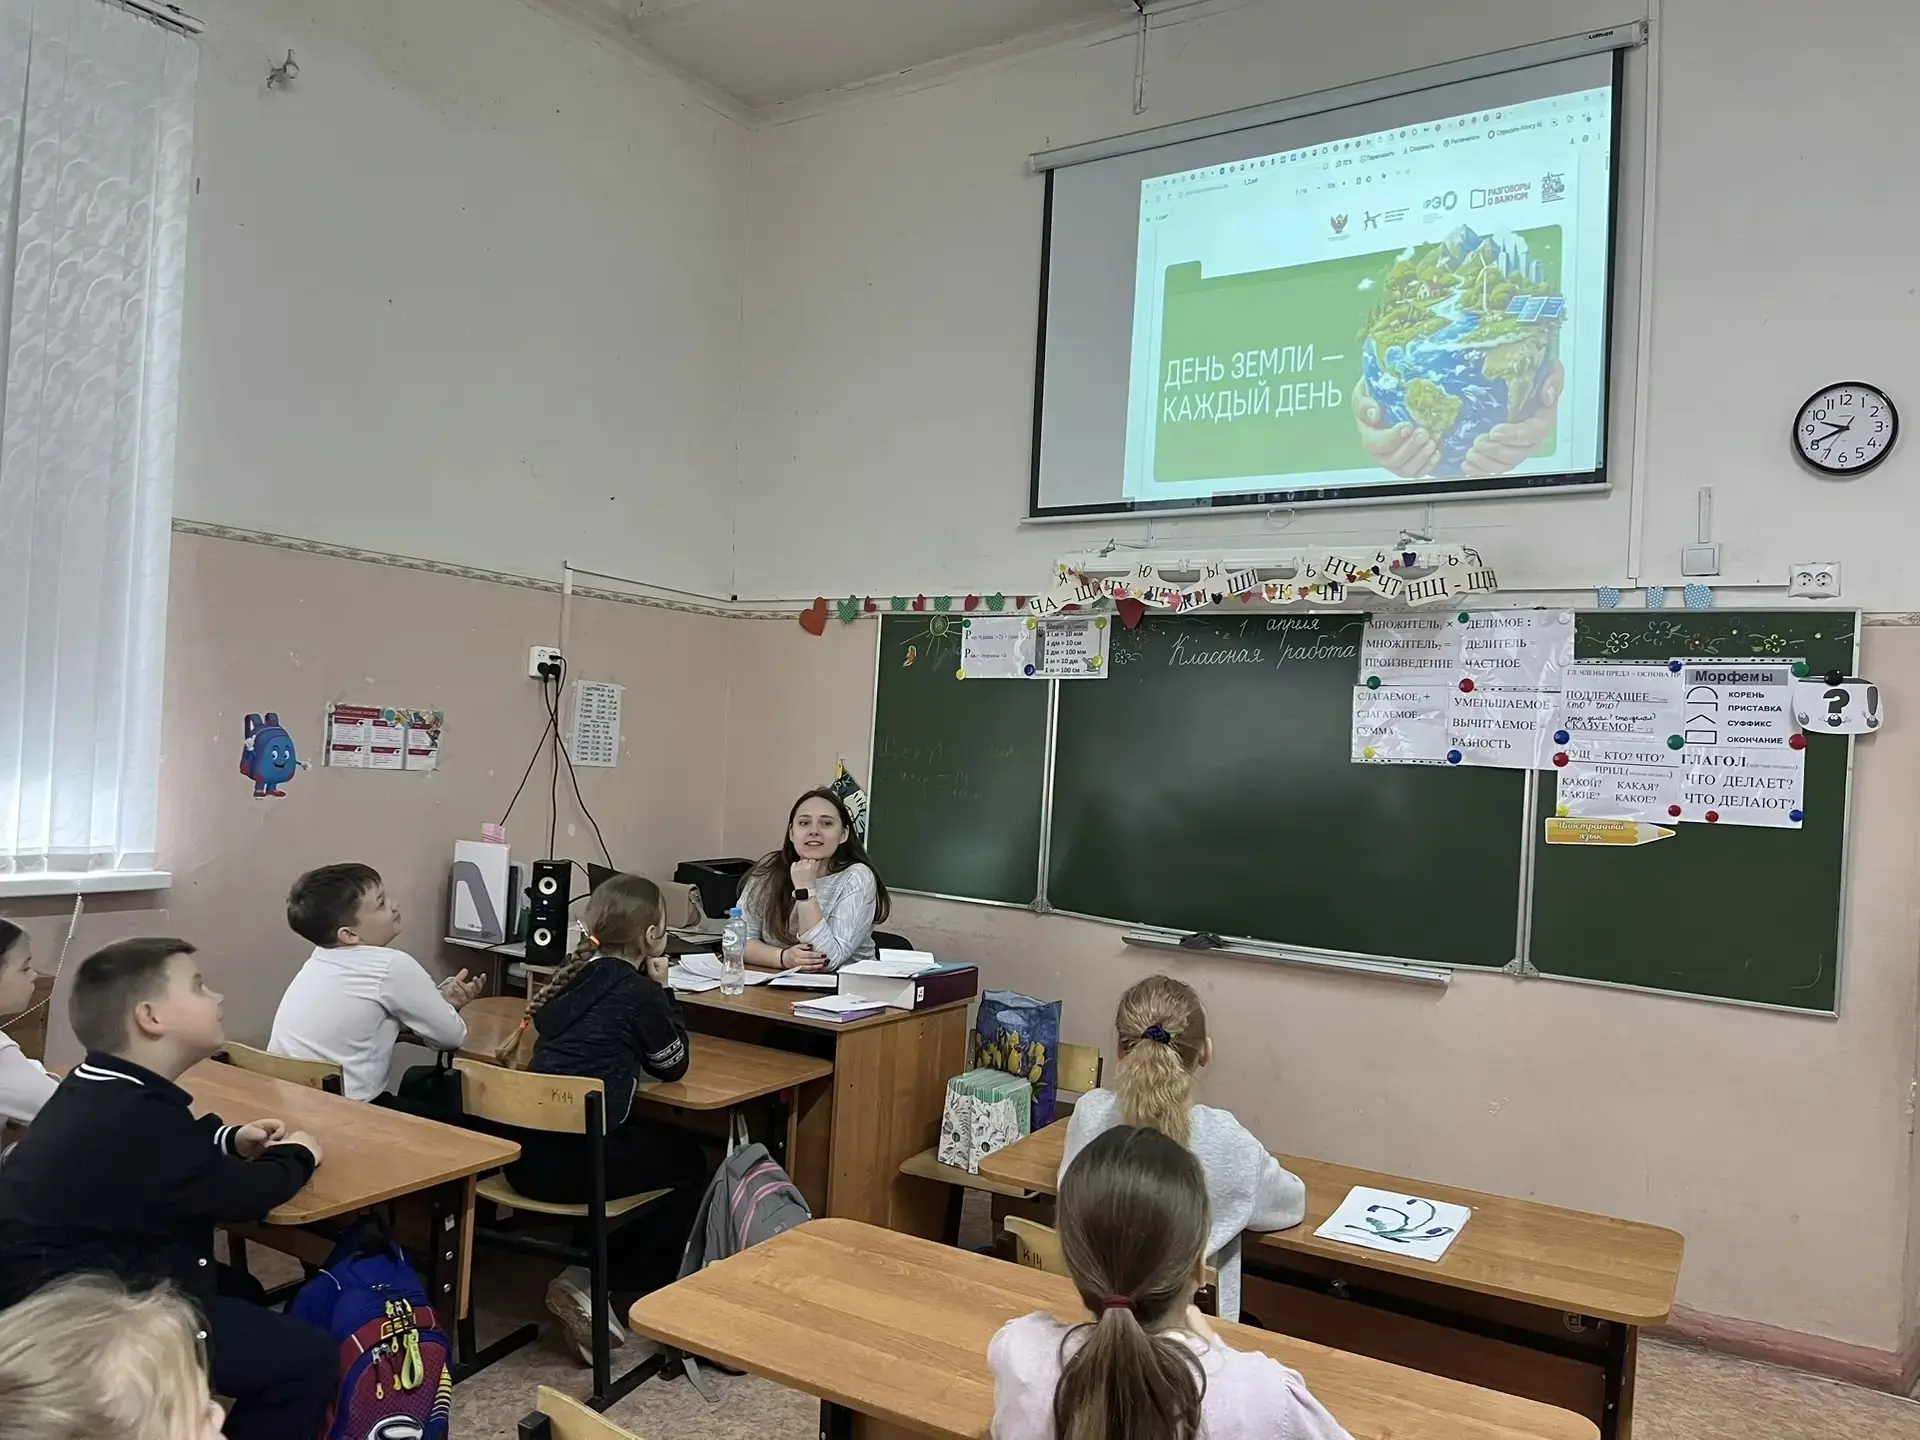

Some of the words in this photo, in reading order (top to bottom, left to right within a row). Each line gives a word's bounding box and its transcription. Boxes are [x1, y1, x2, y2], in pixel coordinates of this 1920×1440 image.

[1488, 182, 1532, 197] РАЗГОВОРЫ
[1487, 197, 1494, 206] О
[1495, 191, 1529, 205] ВАЖНОМ
[1163, 355, 1225, 392] ДЕНЬ
[1230, 343, 1314, 380] ЗЕМЛИ
[1163, 379, 1270, 424] КАЖДЫЙ
[1275, 380, 1343, 418] ДЕНЬ
[1826, 399, 1835, 410] 11
[1840, 394, 1853, 406] 12
[1812, 409, 1827, 421] 10
[1870, 405, 1879, 418] 2
[1805, 424, 1815, 436] 9
[1874, 421, 1884, 433] 3
[1810, 439, 1820, 451] 8
[1867, 437, 1877, 448] 4
[1823, 448, 1831, 460] 7
[1838, 452, 1848, 463] 6
[1855, 447, 1865, 459] 5
[1227, 568, 1258, 594] ШИ
[1378, 574, 1402, 596] ЧТ
[1407, 577, 1449, 602] НЩ
[1467, 570, 1498, 593] ЩН
[1316, 584, 1345, 601] ЧН
[1029, 596, 1059, 613] ЧА
[1466, 617, 1524, 630] ДЕЛИМОЕ
[1239, 618, 1249, 638] 1
[1266, 617, 1321, 650] апреля
[1465, 638, 1527, 650] ДЕЛИТЕЛЬ
[1168, 632, 1265, 666] Классная
[1276, 634, 1357, 670] работа
[1365, 658, 1454, 669] ПРОИЗВЕДЕНИЕ
[1465, 658, 1521, 668] ЧАСТНОЕ
[1580, 669, 1605, 677] ЧЛЕНЫ
[1694, 670, 1773, 685] Морфемы
[1566, 690, 1650, 702] ПОДЛЕЖАЩЕЕ
[1728, 691, 1765, 699] КОРЕНЬ
[1454, 697, 1550, 710] УМЕНЬШАЕМОЕ
[1727, 704, 1782, 713] ПРИСТАВКА
[1453, 717, 1537, 731] ВЫЧИТАЕМОЕ
[1564, 721, 1635, 732] СКАЗУЕМОЕ
[1727, 719, 1773, 728] СУФФИКС
[1356, 727, 1394, 736] СУММА
[1451, 737, 1512, 749] РАЗНОСТЬ
[1726, 736, 1784, 745] ОКОНЧАНИЕ
[1604, 751, 1633, 761] КТО?
[1635, 752, 1665, 763] ЧТО?
[1681, 754, 1746, 767] ГЛАГОЛ
[1562, 777, 1602, 788] КАКОЙ?
[1617, 781, 1659, 791] КАКАЯ?
[1685, 773, 1716, 786] ЧТО
[1722, 774, 1794, 790] ДЕЛАЕТ?
[1561, 790, 1600, 801] КАКИЕ?
[1615, 793, 1657, 804] КАКОЕ?
[1685, 792, 1715, 805] ЧТО
[1718, 794, 1796, 810] ДЕЛАЮТ?
[1556, 821, 1624, 834] Иностранный
[1578, 833, 1602, 843] язык
